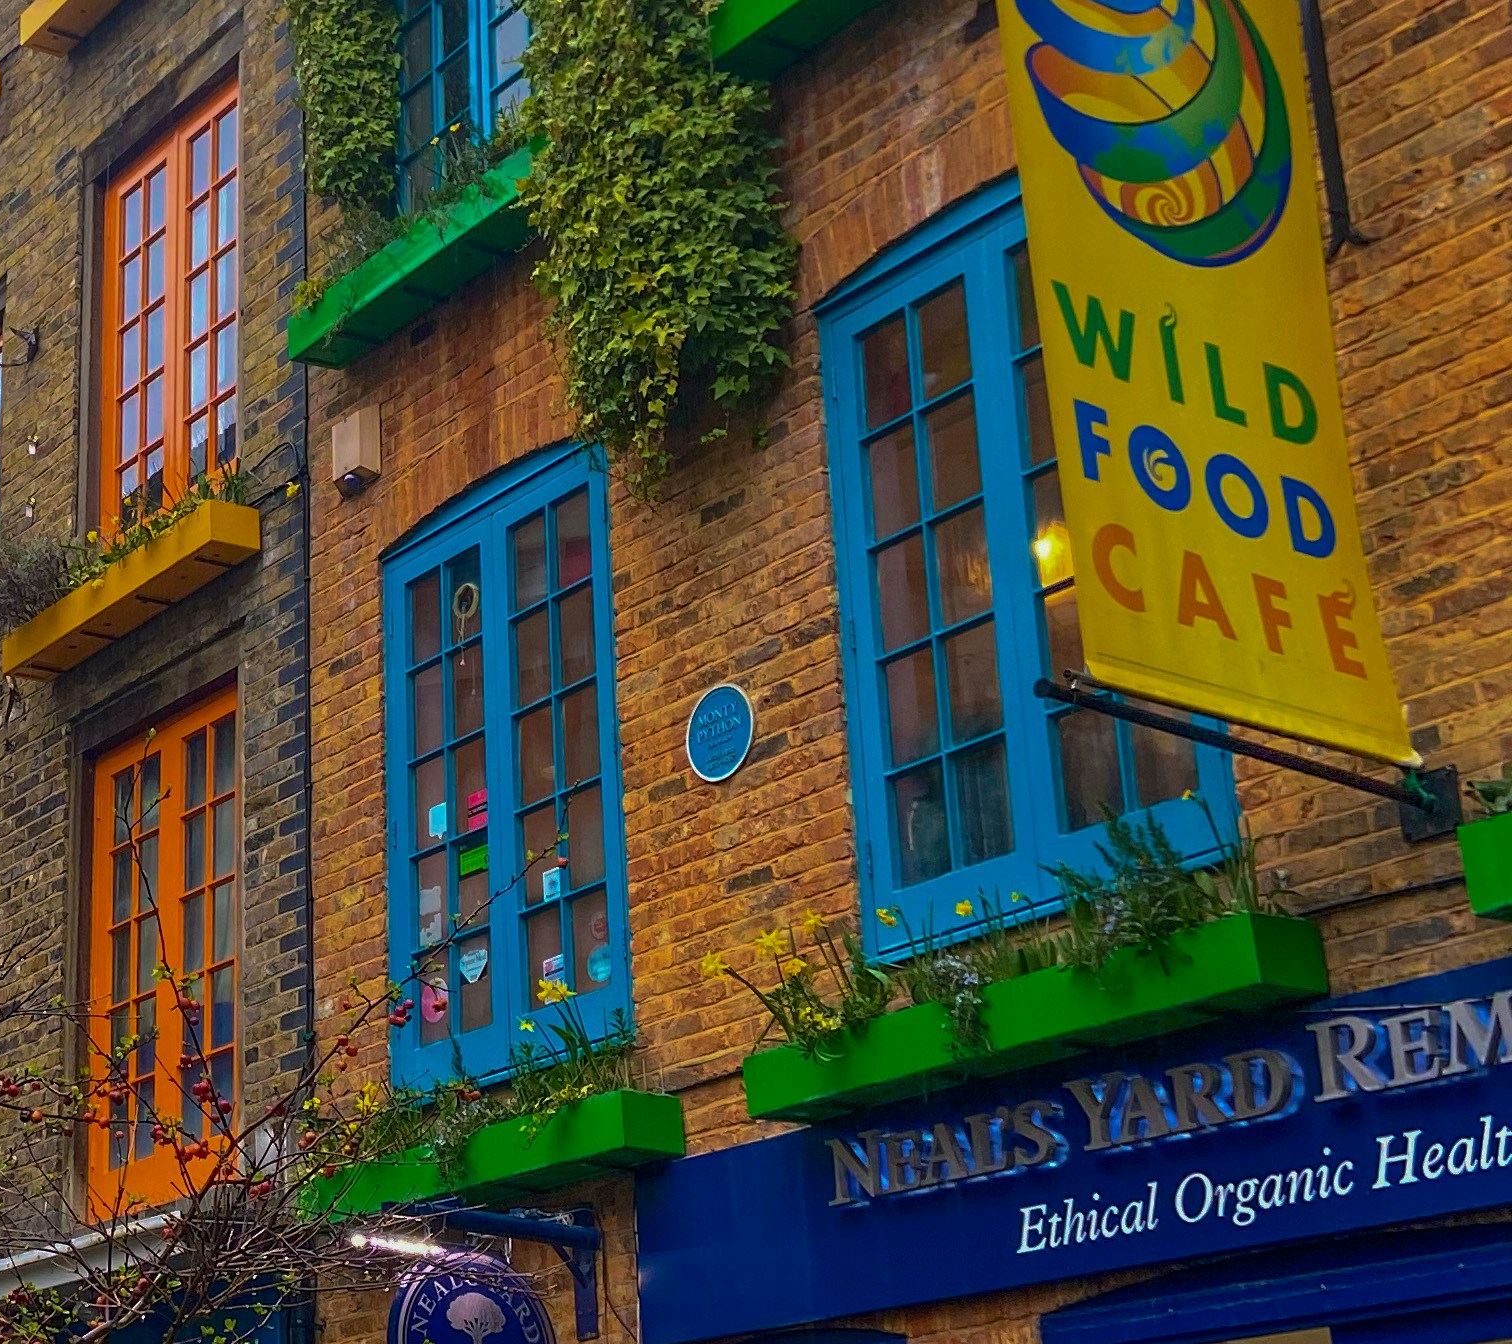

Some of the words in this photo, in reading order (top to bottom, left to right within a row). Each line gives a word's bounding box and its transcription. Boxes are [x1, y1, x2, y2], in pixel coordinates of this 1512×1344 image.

[1051, 280, 1318, 445] WILD
[1073, 398, 1336, 558] FOOD
[696, 715, 742, 744] PYTHON
[697, 701, 737, 727] MONTY
[824, 1100, 1067, 1206] NEAL'S
[1063, 1048, 1292, 1152] YARD
[1016, 1181, 1159, 1254] Ethical
[1174, 1147, 1354, 1226] Organic
